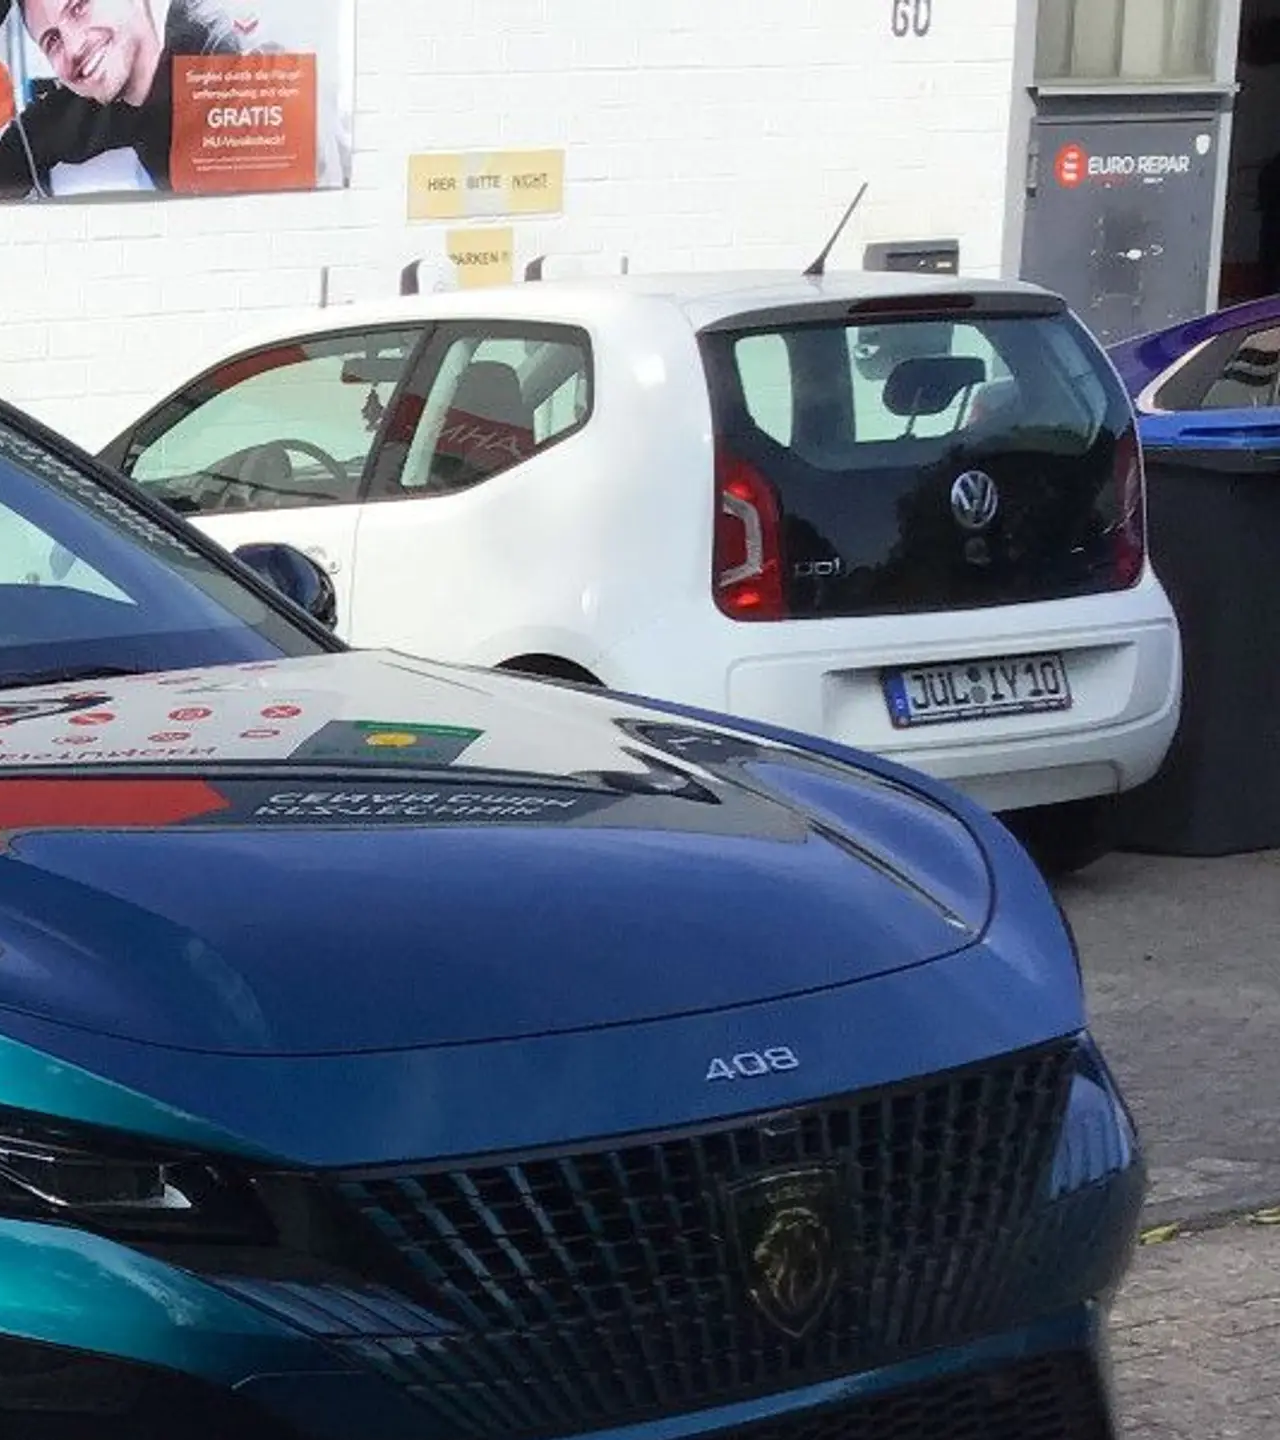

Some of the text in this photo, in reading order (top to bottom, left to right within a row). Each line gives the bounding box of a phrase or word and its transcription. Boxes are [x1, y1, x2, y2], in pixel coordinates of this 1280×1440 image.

[206, 105, 283, 128] GRATIS
[1087, 156, 1190, 174] EURO REPAR
[465, 174, 502, 190] BITTE
[705, 1046, 800, 1080] 408
